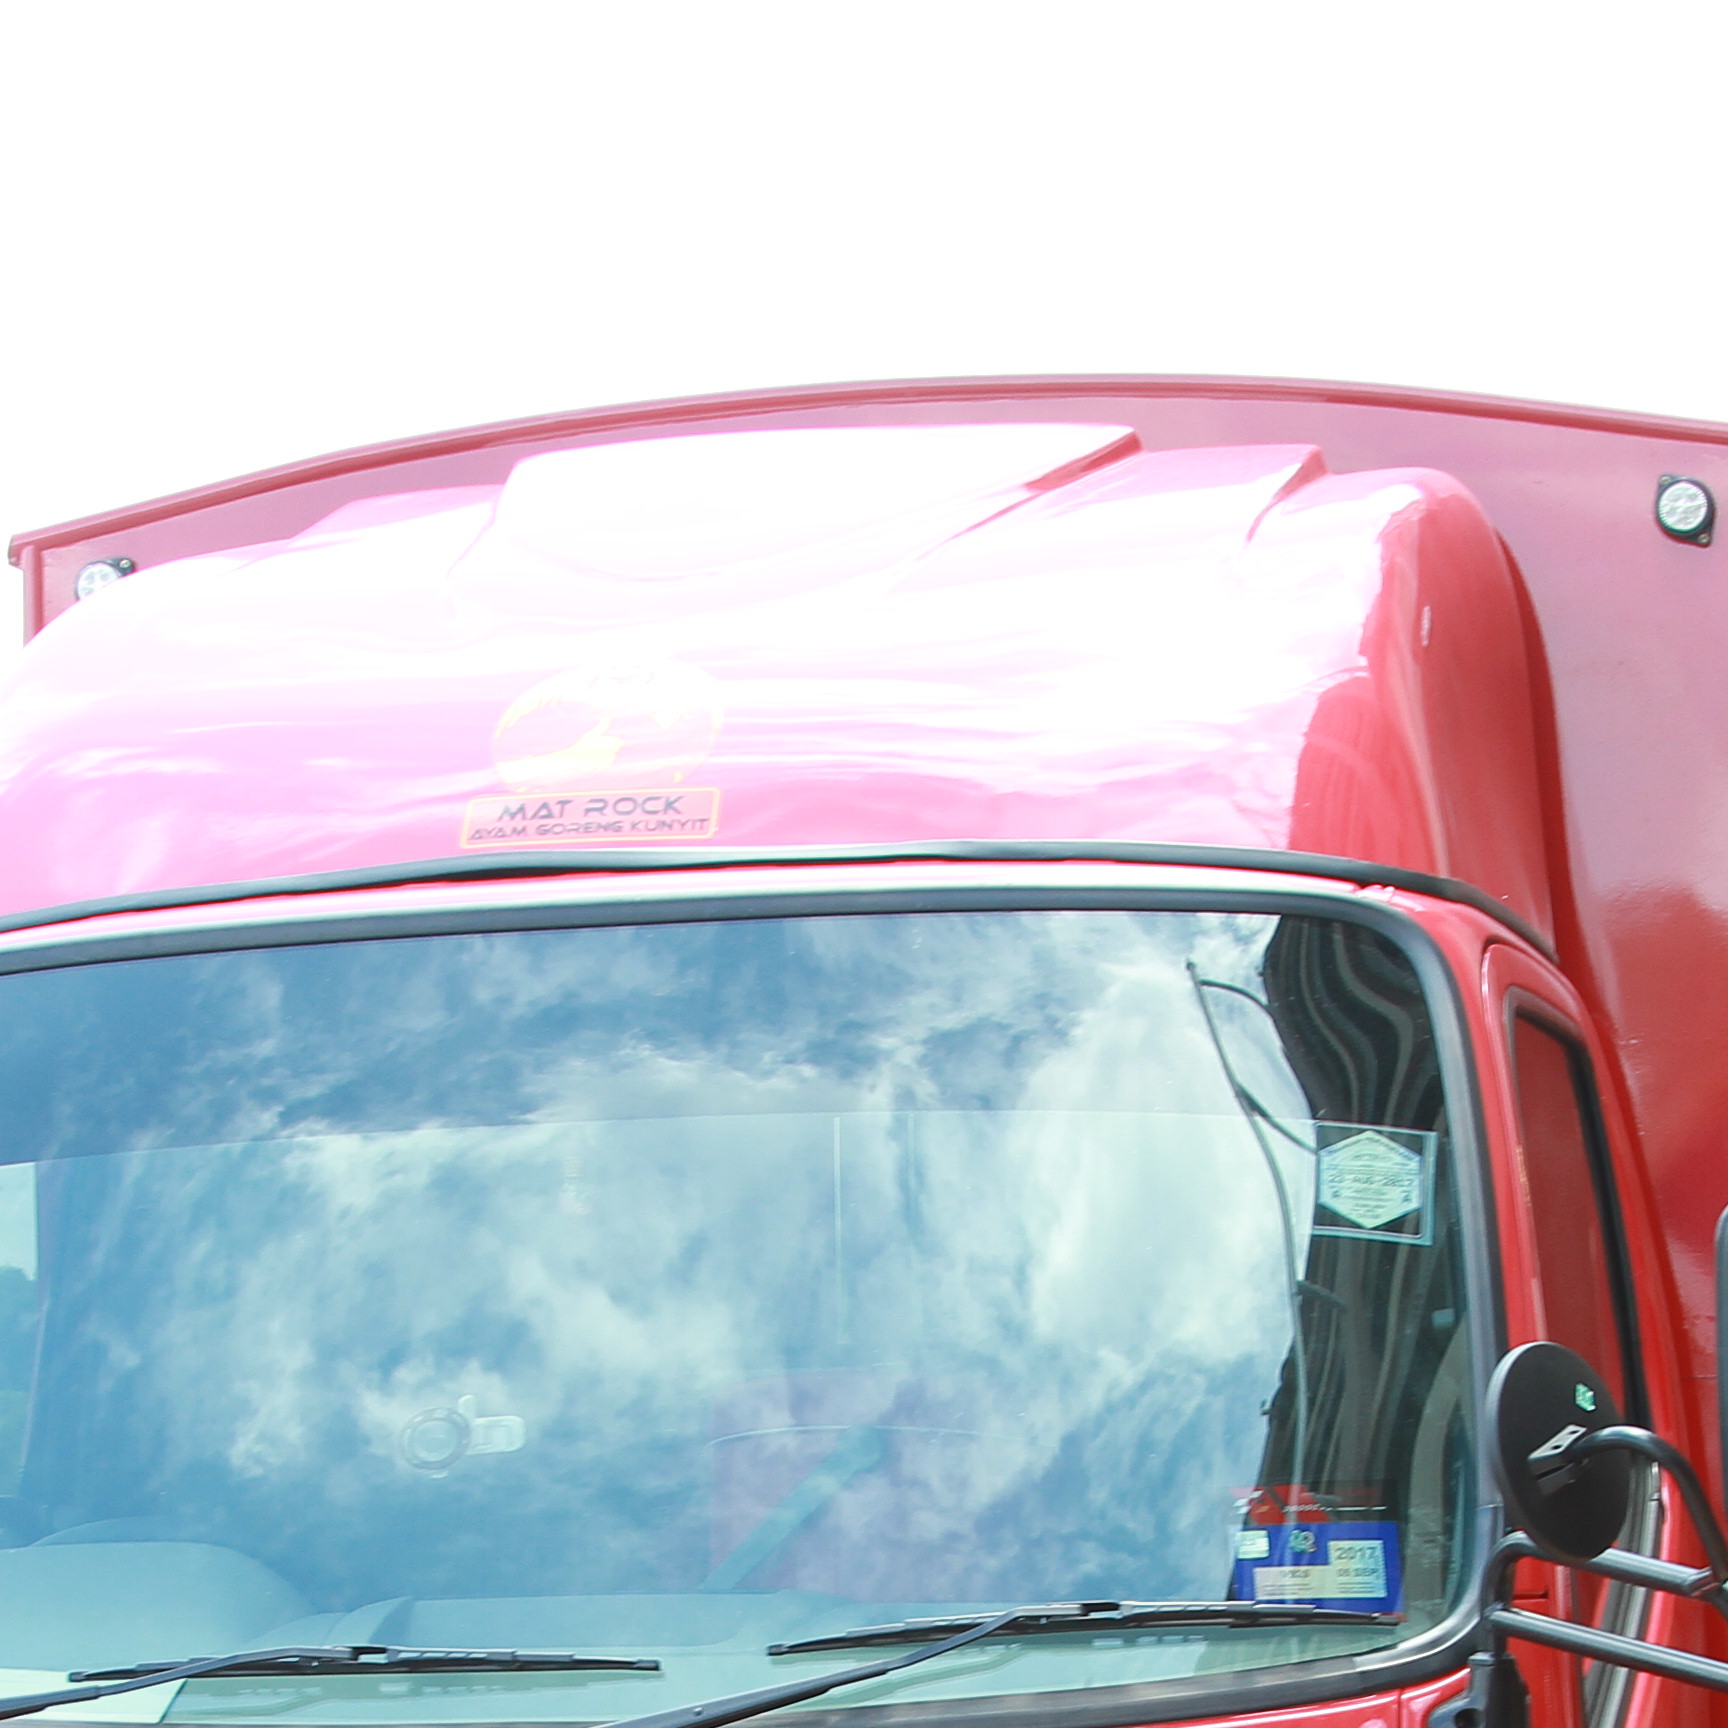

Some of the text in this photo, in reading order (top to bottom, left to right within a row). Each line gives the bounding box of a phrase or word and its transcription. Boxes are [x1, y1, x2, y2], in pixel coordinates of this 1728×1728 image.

[497, 796, 683, 821] MAT ROCK
[467, 818, 710, 840] AYAM GORENG KUNYIT
[1335, 1546, 1378, 1560] 2017
